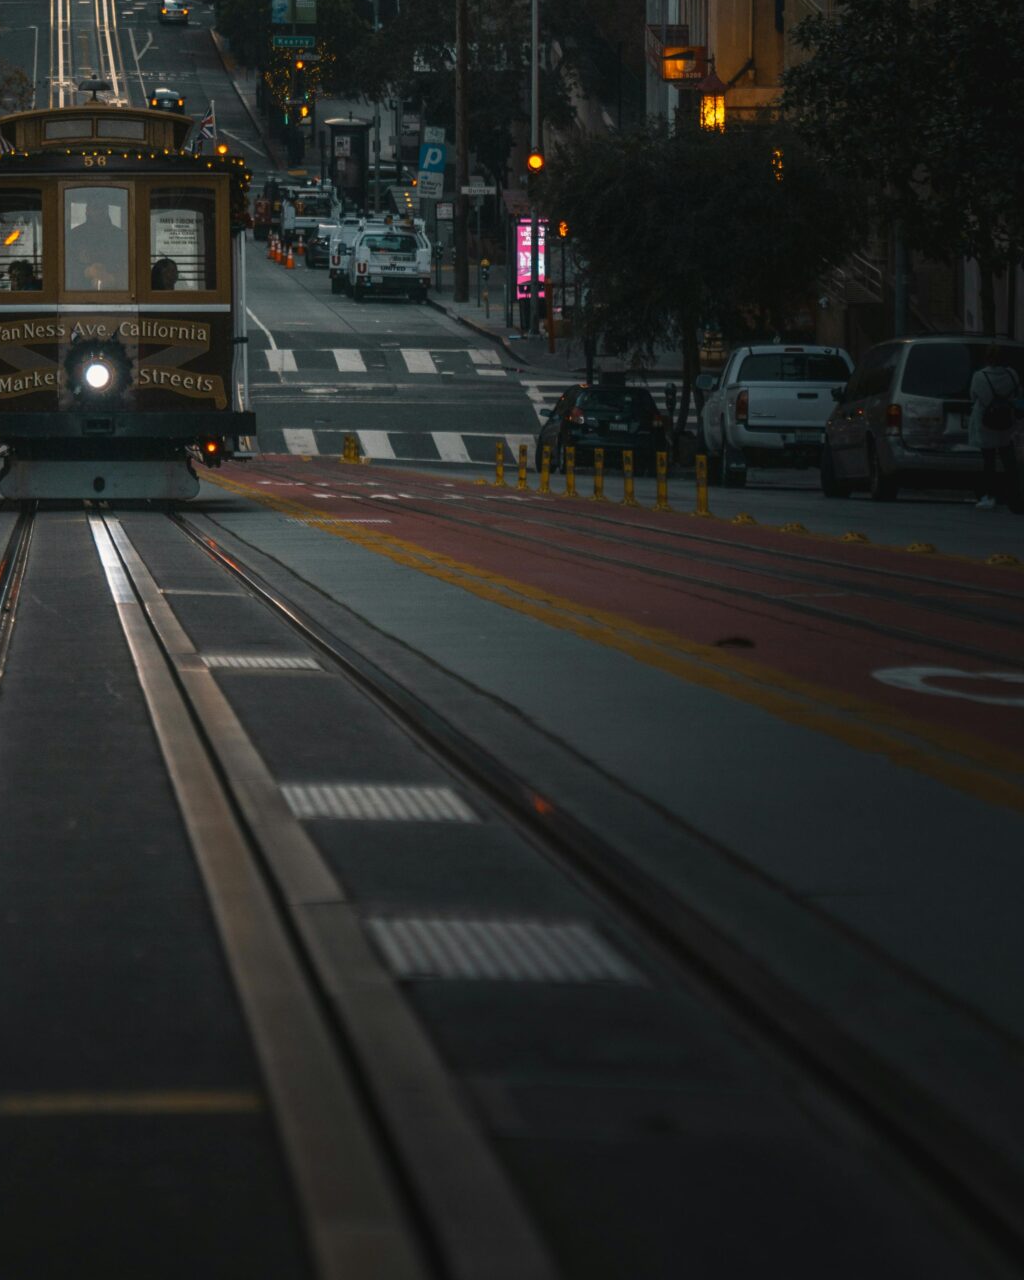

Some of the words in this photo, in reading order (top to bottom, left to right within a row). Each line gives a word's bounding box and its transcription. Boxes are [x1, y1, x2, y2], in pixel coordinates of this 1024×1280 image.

[278, 38, 309, 47] Kearny
[84, 155, 107, 168] 56
[357, 262, 367, 274] U
[380, 264, 406, 272] UNITED
[23, 323, 66, 339] Ness
[119, 322, 208, 341] California
[139, 369, 214, 392] Streets
